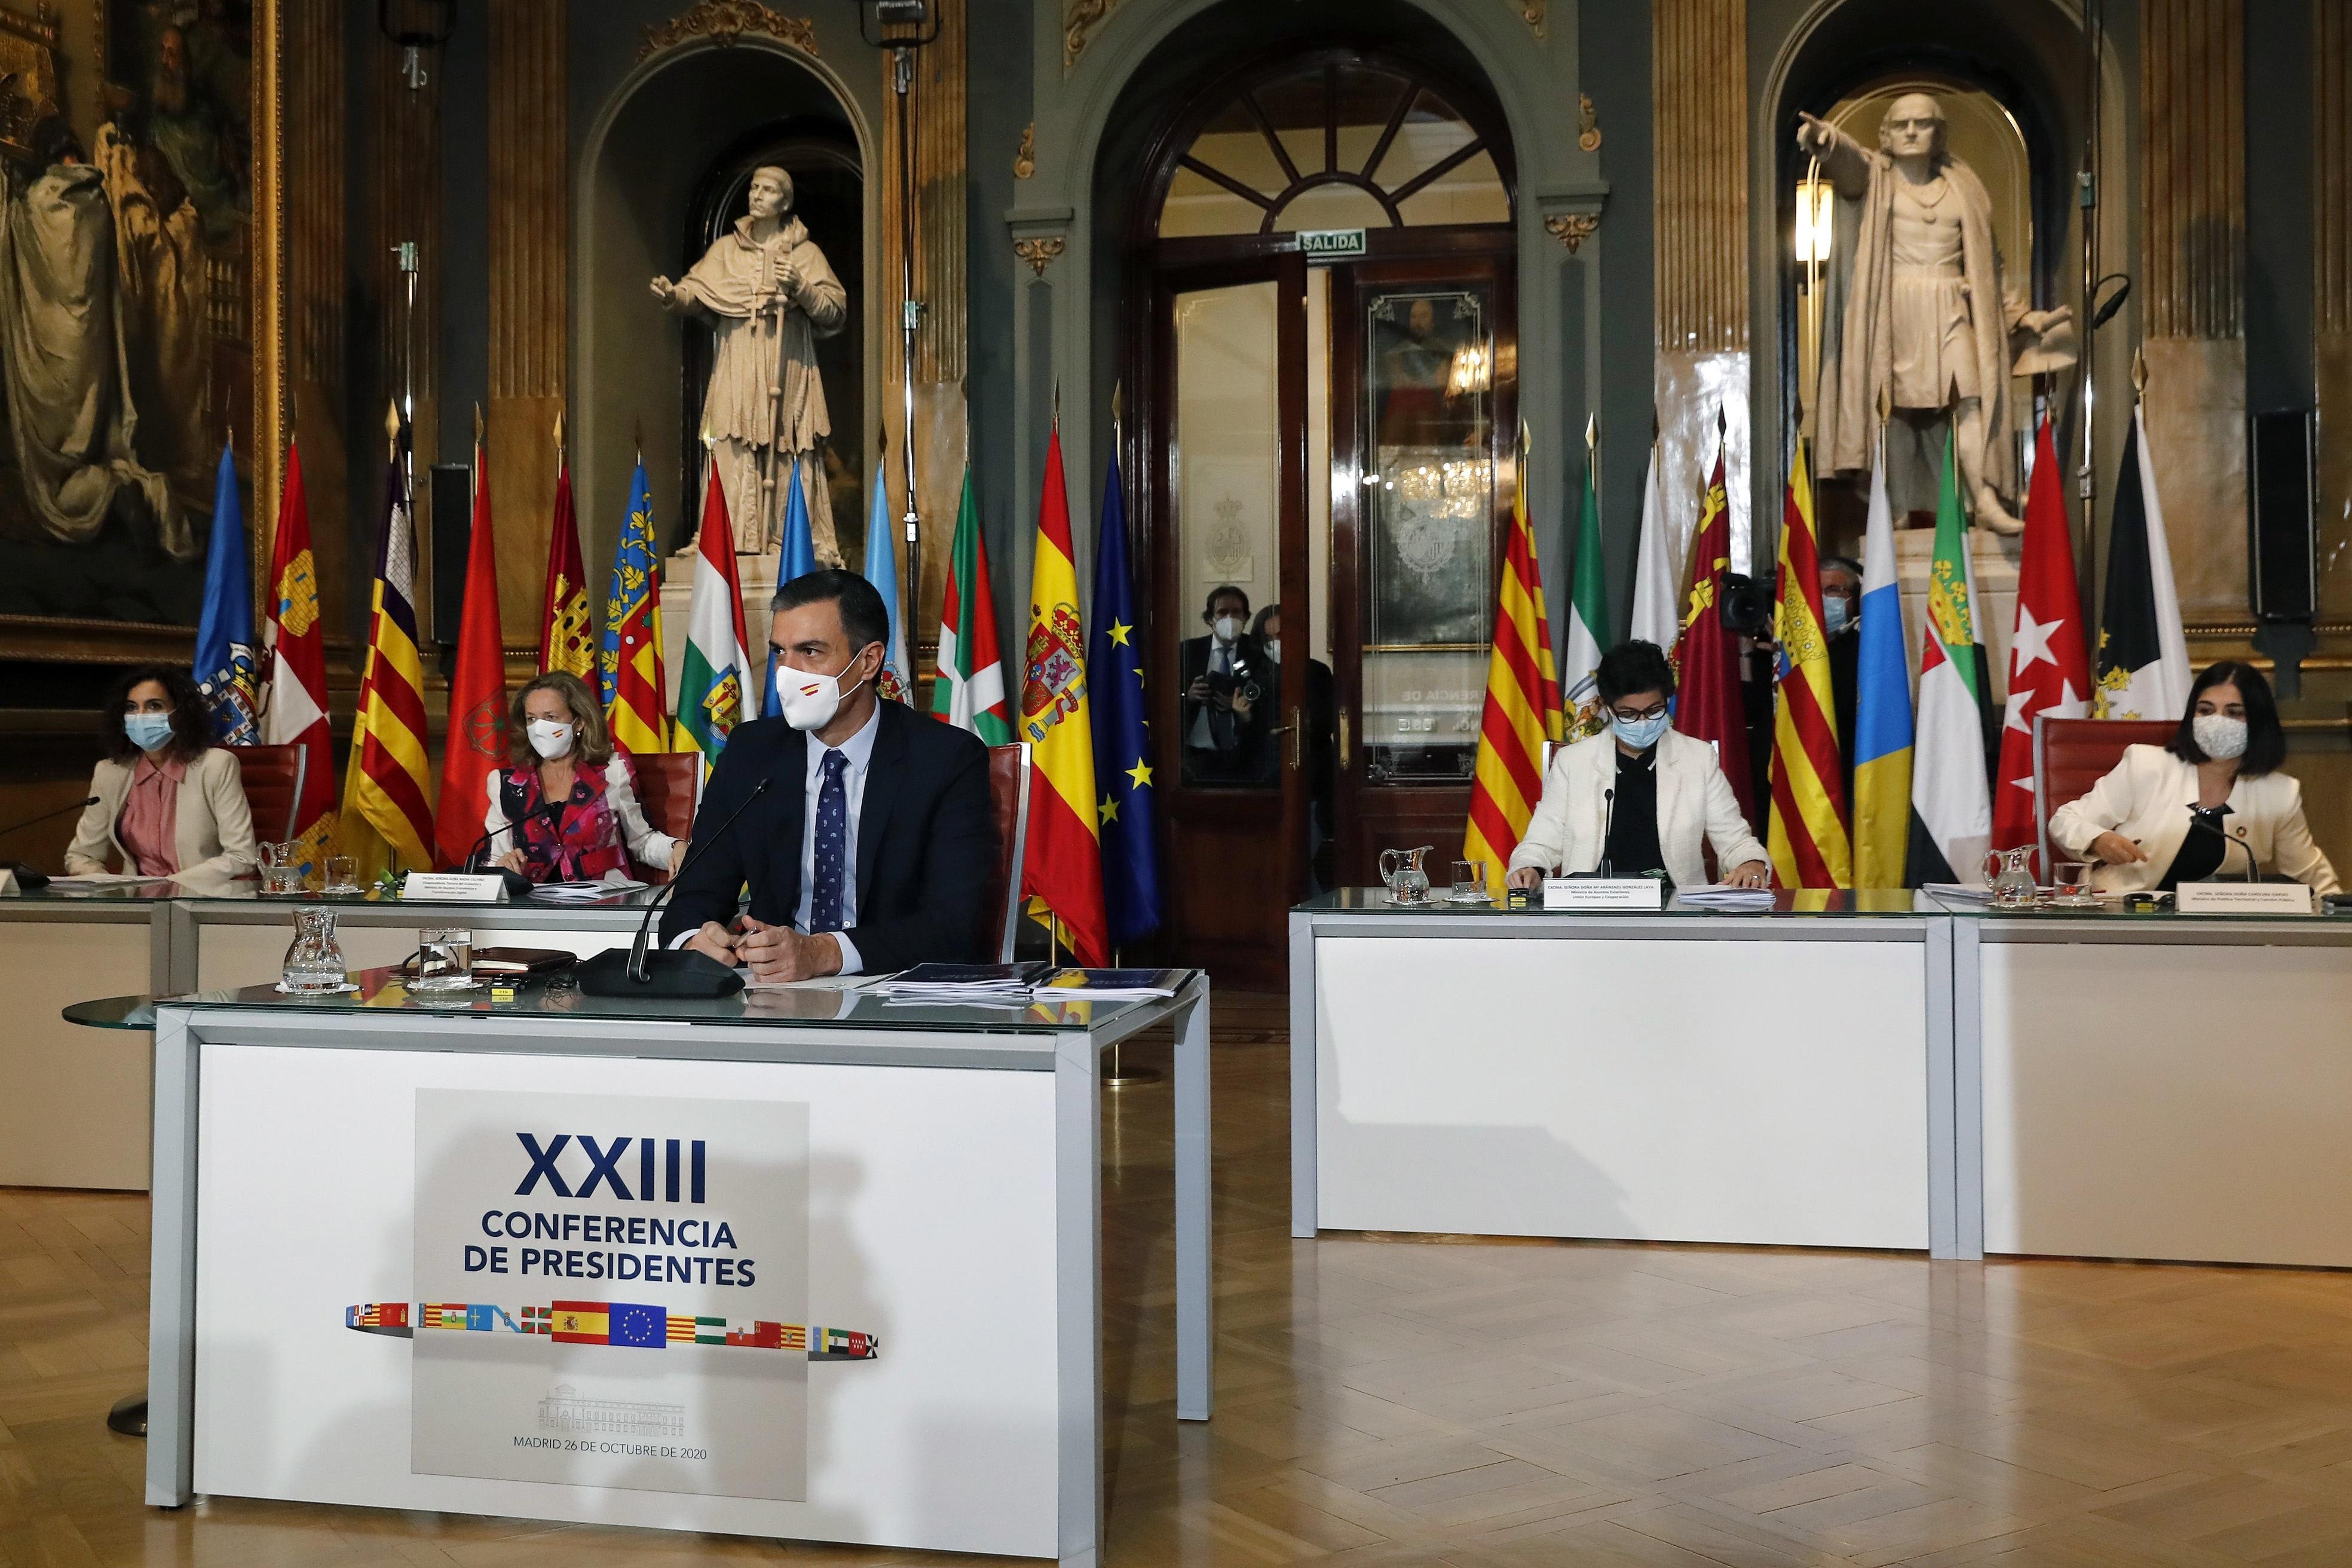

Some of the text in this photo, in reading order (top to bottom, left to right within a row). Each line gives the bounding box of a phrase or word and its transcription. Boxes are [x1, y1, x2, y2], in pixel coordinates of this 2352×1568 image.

[1303, 234, 1360, 251] SALIDA
[514, 1133, 705, 1203] XXIII
[482, 1211, 737, 1249] CONFERENCIA
[465, 1245, 755, 1287] DE PRESIDENTES
[514, 1437, 706, 1459] MADRID 26 DE OCTUBRE DE 2020
